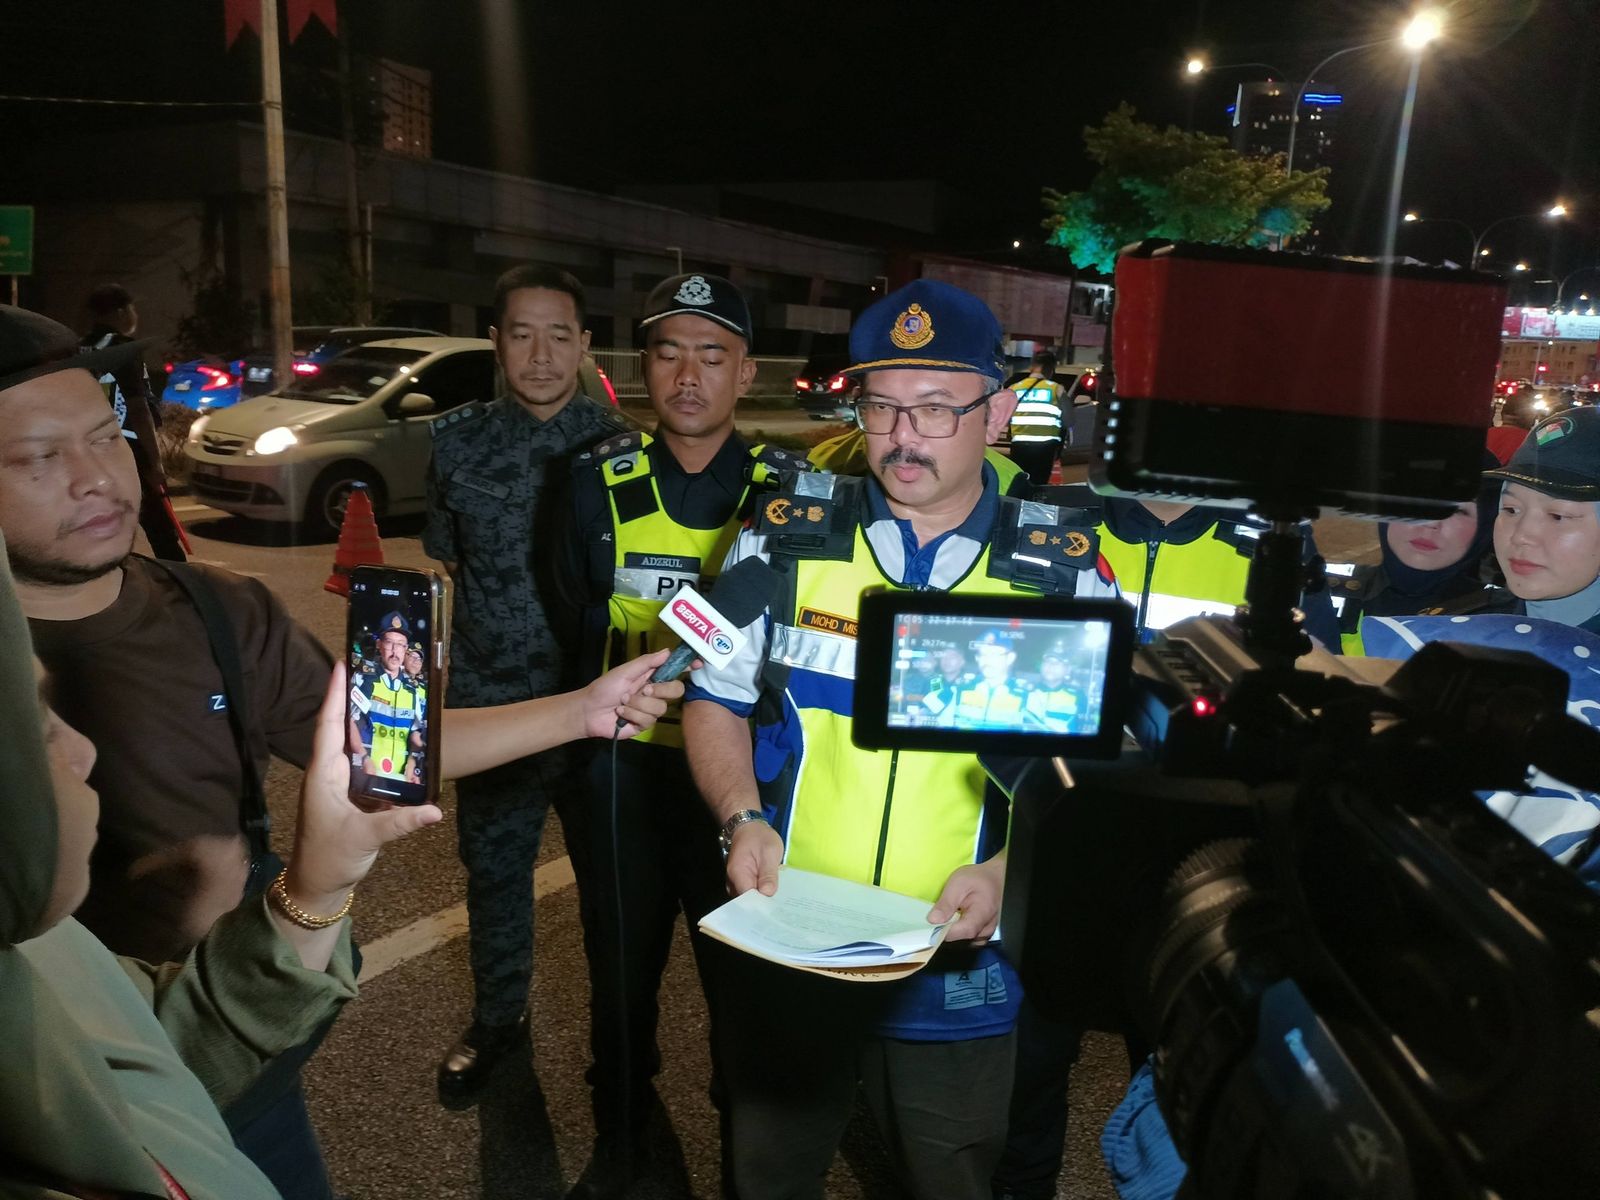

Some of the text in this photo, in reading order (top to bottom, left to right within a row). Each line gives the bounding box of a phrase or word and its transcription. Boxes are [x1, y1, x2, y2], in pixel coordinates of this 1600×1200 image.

[641, 556, 683, 568] ADZRUL
[675, 603, 709, 634] BERITA
[810, 614, 839, 630] MOHD
[211, 694, 226, 711] Z
